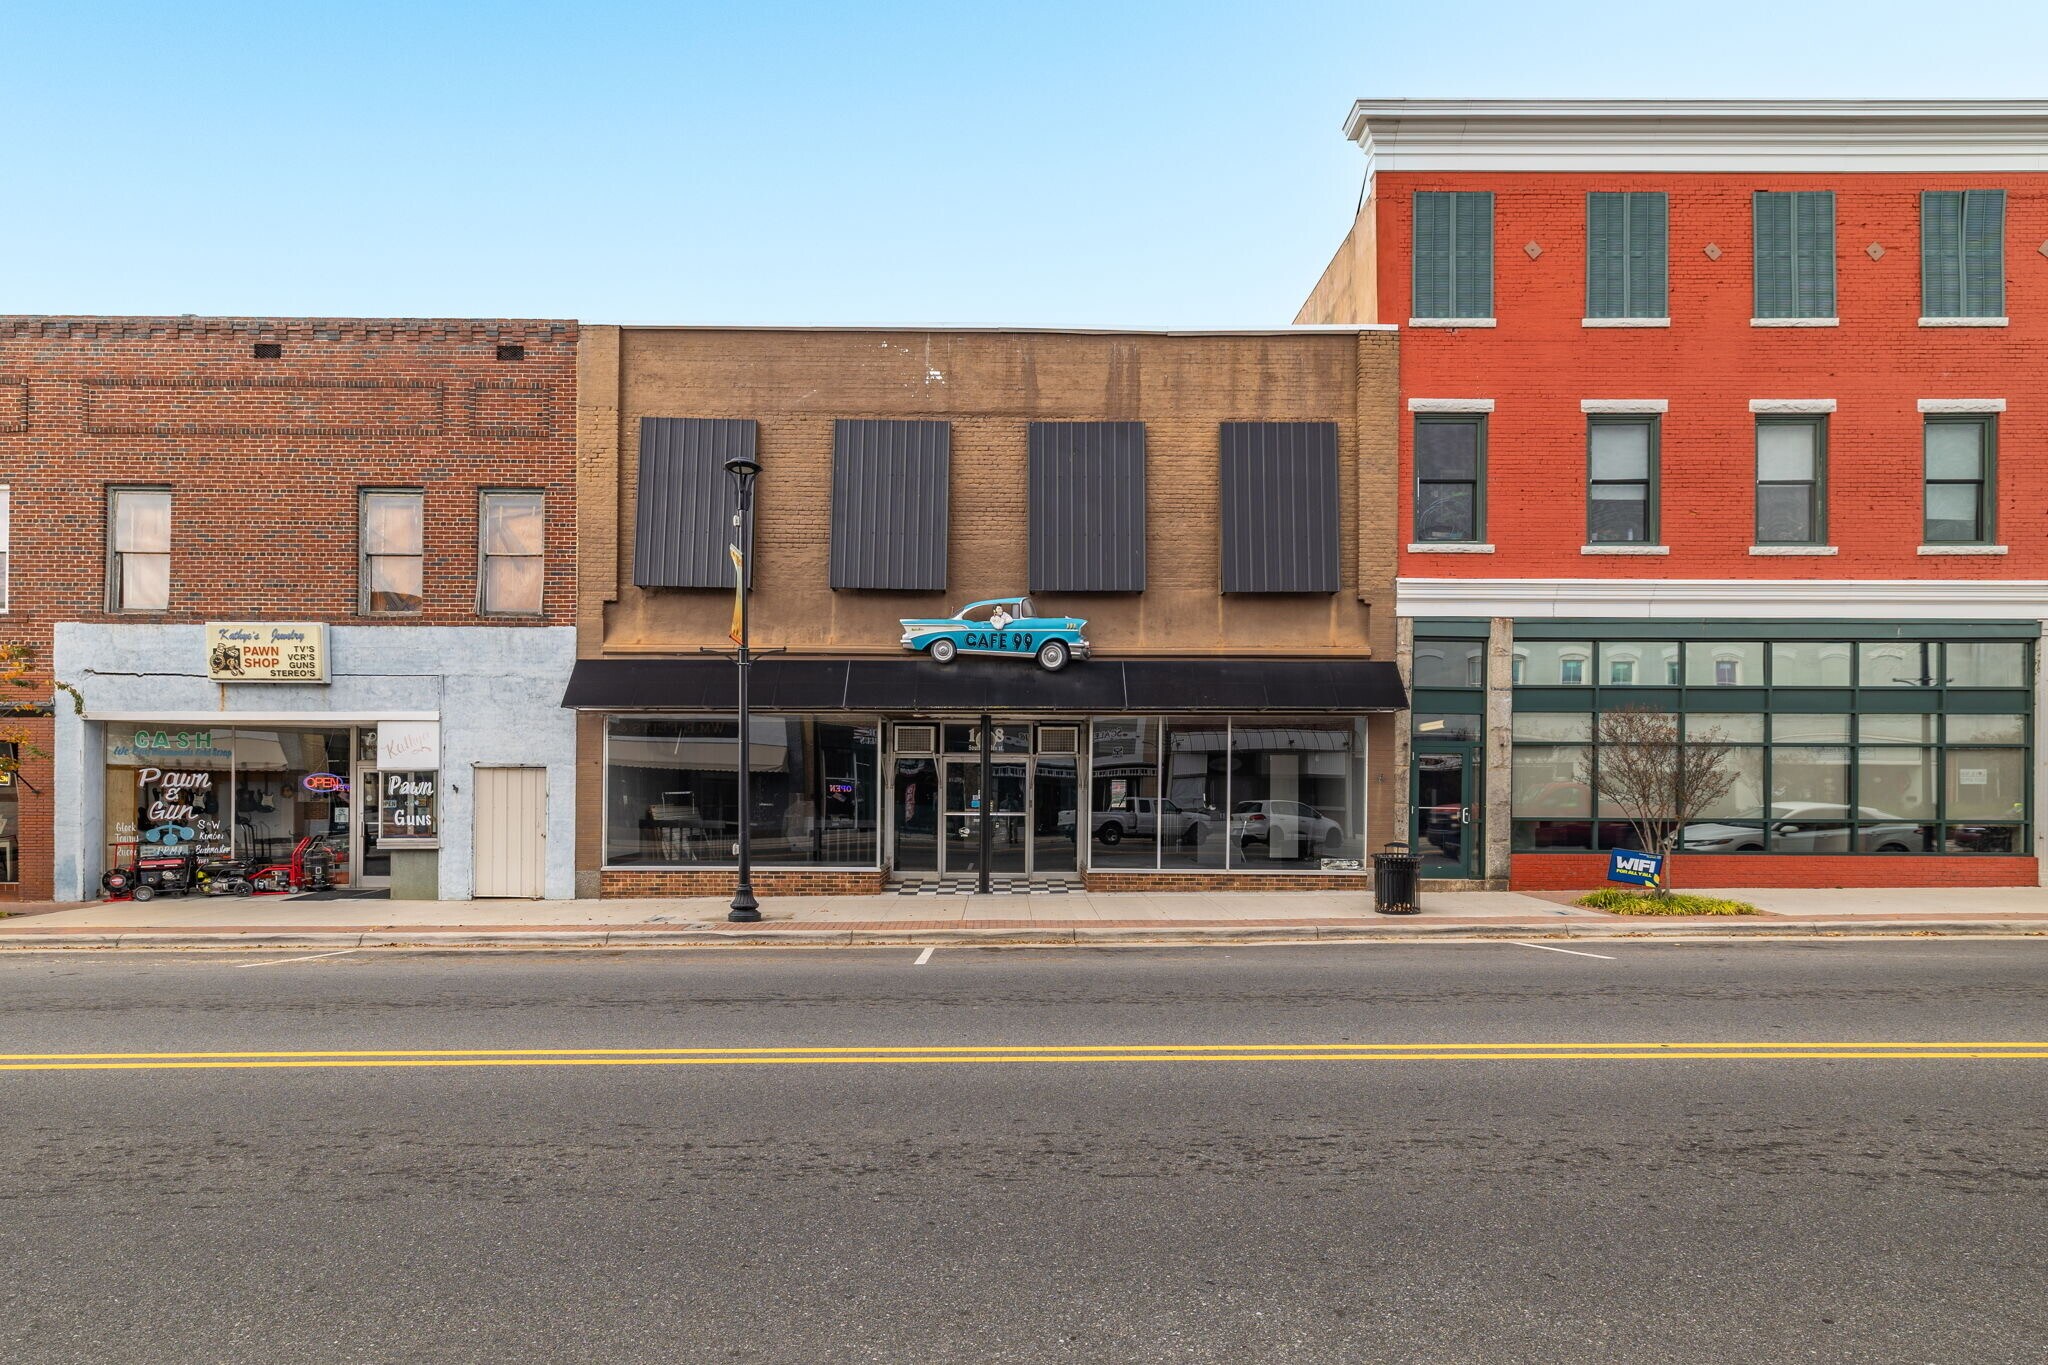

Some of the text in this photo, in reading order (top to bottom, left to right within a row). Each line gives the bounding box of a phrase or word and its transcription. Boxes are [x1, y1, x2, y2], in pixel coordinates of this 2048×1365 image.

[271, 628, 305, 643] Jewelry
[965, 633, 1033, 650] CAFE 99
[243, 646, 279, 656] PAWN
[244, 658, 279, 668] SHOP
[135, 730, 211, 748] CASH
[139, 767, 212, 788] Pawn
[306, 777, 339, 788] OPEN
[388, 775, 434, 796] Pawn
[165, 788, 180, 800] &
[149, 801, 199, 820] Gun
[116, 822, 136, 832] Glock
[1616, 856, 1656, 873] WIFI
